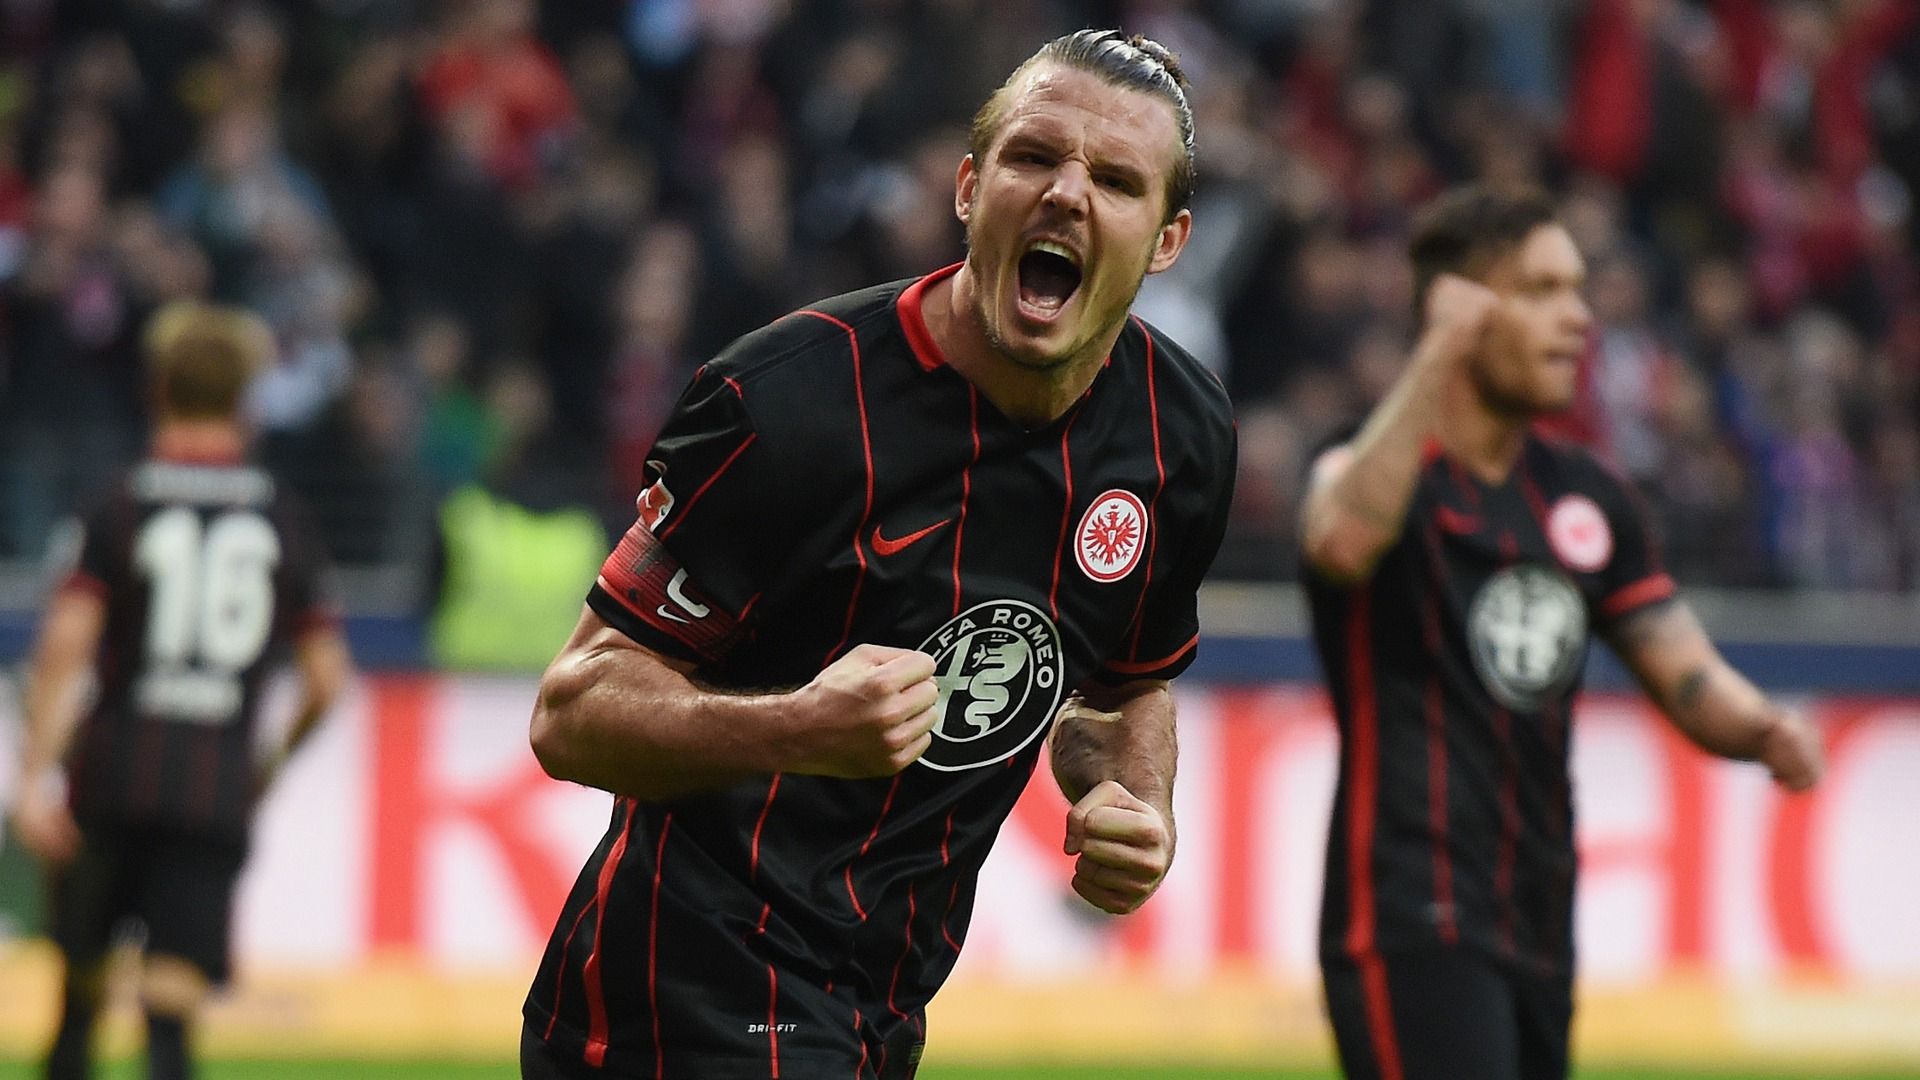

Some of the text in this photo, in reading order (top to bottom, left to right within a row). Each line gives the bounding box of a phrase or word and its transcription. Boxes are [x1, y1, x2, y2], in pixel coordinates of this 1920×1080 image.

[134, 507, 281, 670] 16
[932, 608, 1055, 689] FA ROMEO
[747, 1023, 798, 1033] DRI-FIT
